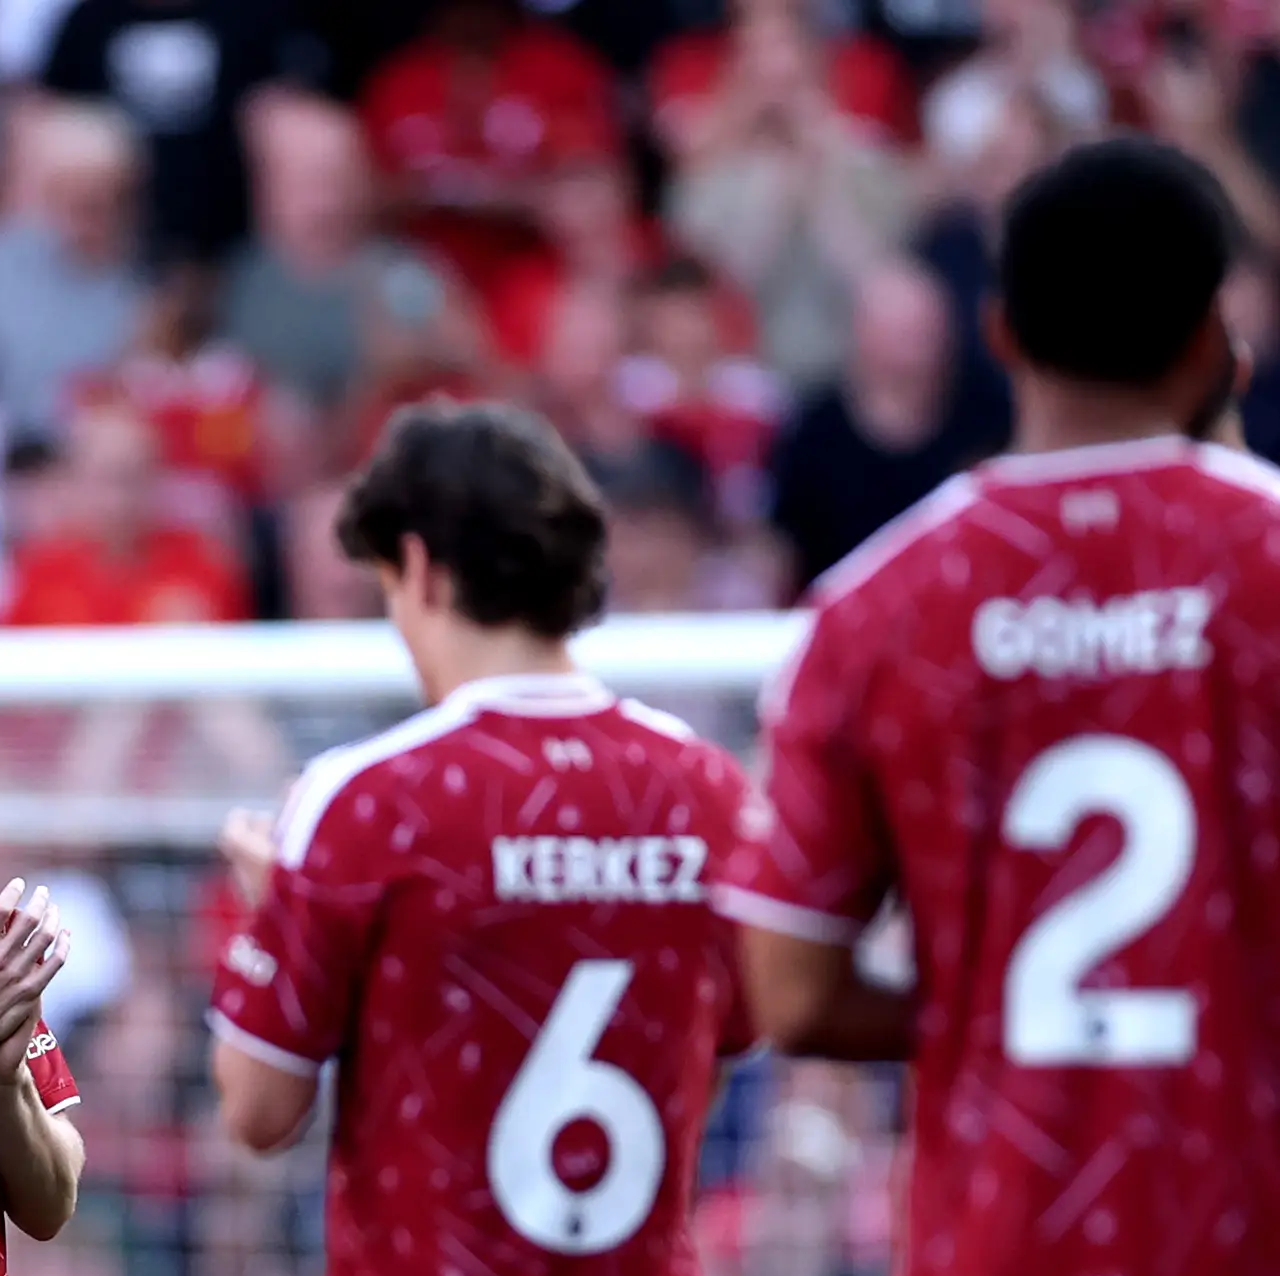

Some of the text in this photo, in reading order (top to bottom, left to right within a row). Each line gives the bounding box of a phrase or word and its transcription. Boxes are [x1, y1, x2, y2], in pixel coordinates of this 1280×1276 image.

[973, 585, 1215, 681] GOMEZ
[493, 835, 708, 903] KERKEZ
[1001, 732, 1197, 1066] 2
[487, 956, 665, 1255] 6
